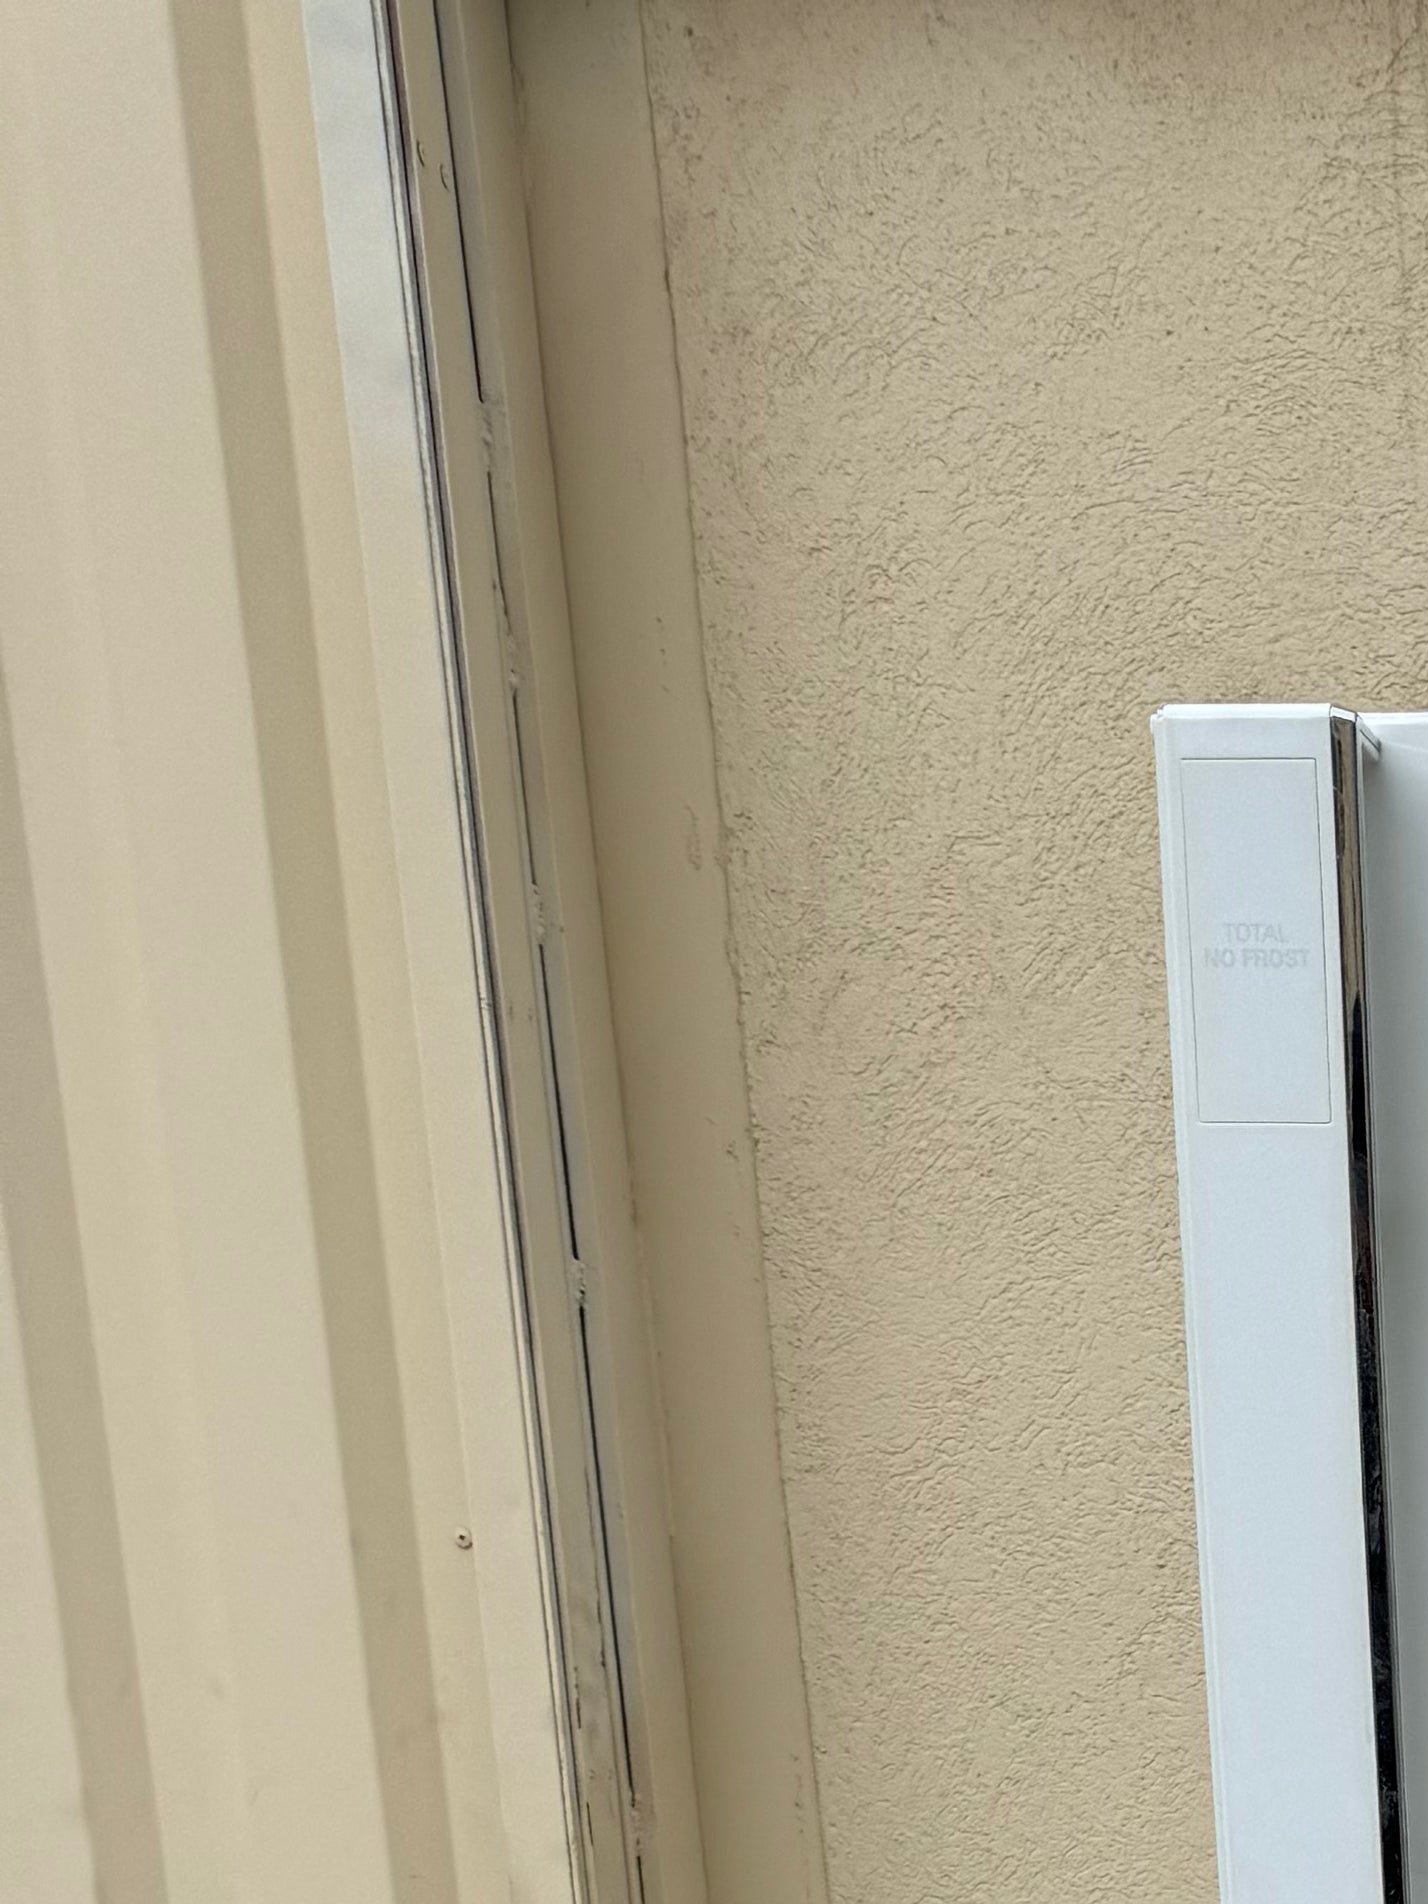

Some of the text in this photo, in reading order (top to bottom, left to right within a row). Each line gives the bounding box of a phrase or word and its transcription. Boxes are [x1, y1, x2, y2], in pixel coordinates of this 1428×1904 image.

[1223, 922, 1289, 943] TOTAL
[1203, 947, 1311, 969] NO FROST
